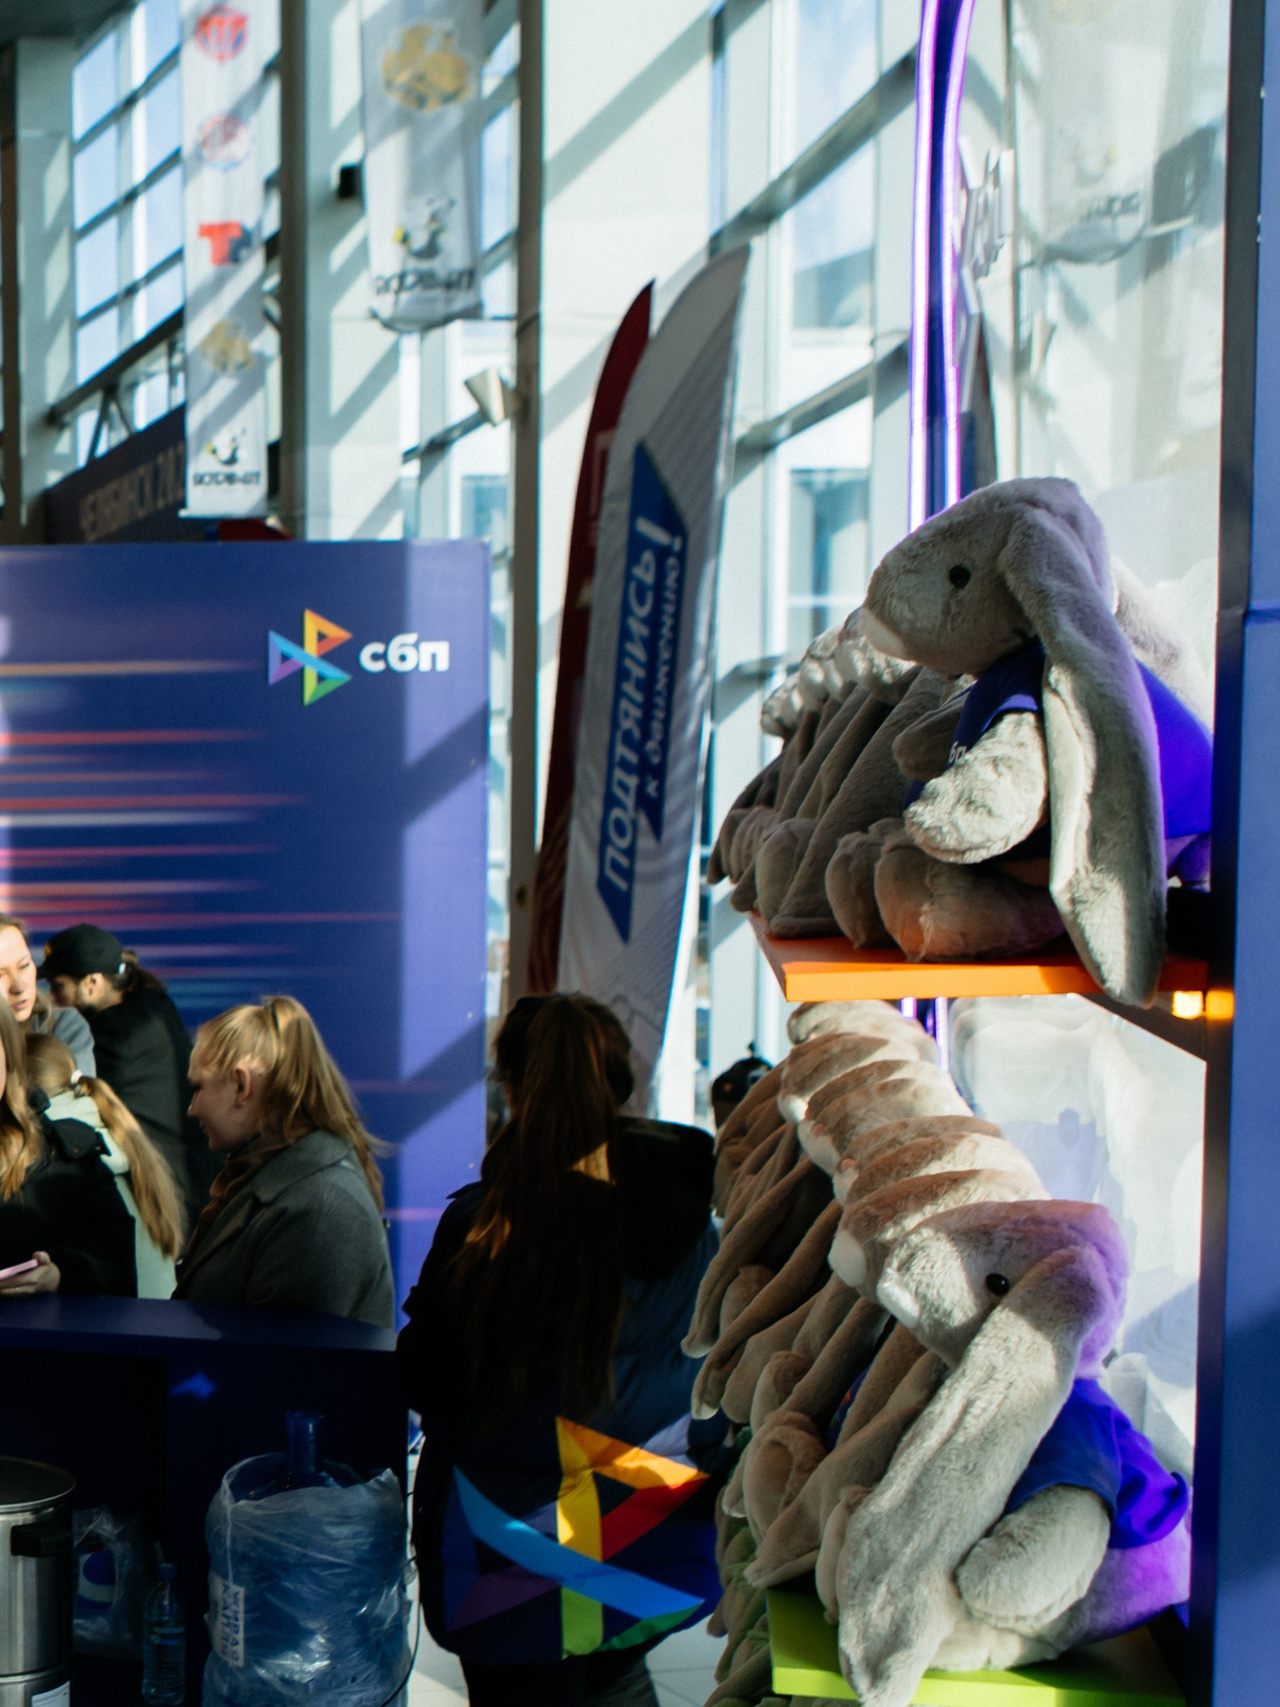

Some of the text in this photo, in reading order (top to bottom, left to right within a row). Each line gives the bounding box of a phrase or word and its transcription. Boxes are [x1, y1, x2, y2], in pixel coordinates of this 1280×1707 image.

[359, 632, 450, 672] сбп
[603, 515, 682, 891] ПОДТЯНИСЬ!
[947, 741, 968, 765] бп
